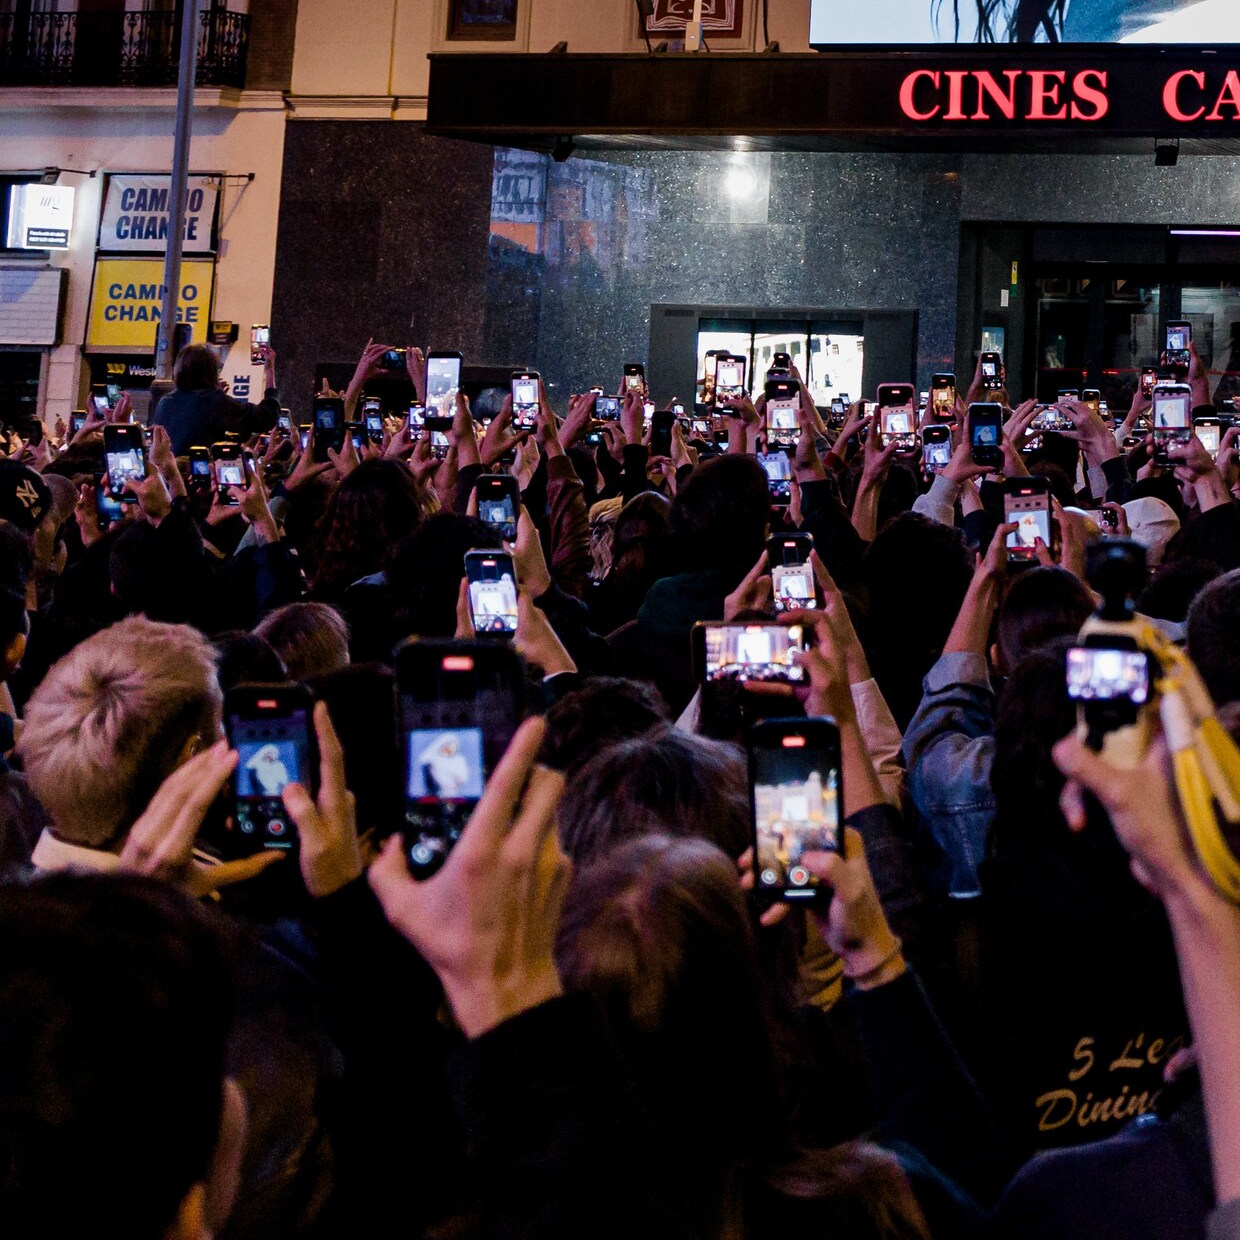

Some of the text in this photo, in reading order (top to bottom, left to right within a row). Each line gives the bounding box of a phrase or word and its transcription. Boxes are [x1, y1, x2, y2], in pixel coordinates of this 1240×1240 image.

[899, 68, 1110, 121] CINES
[120, 187, 204, 213] CAMO
[108, 283, 198, 301] CAMO
[1067, 1036, 1095, 1082] 5
